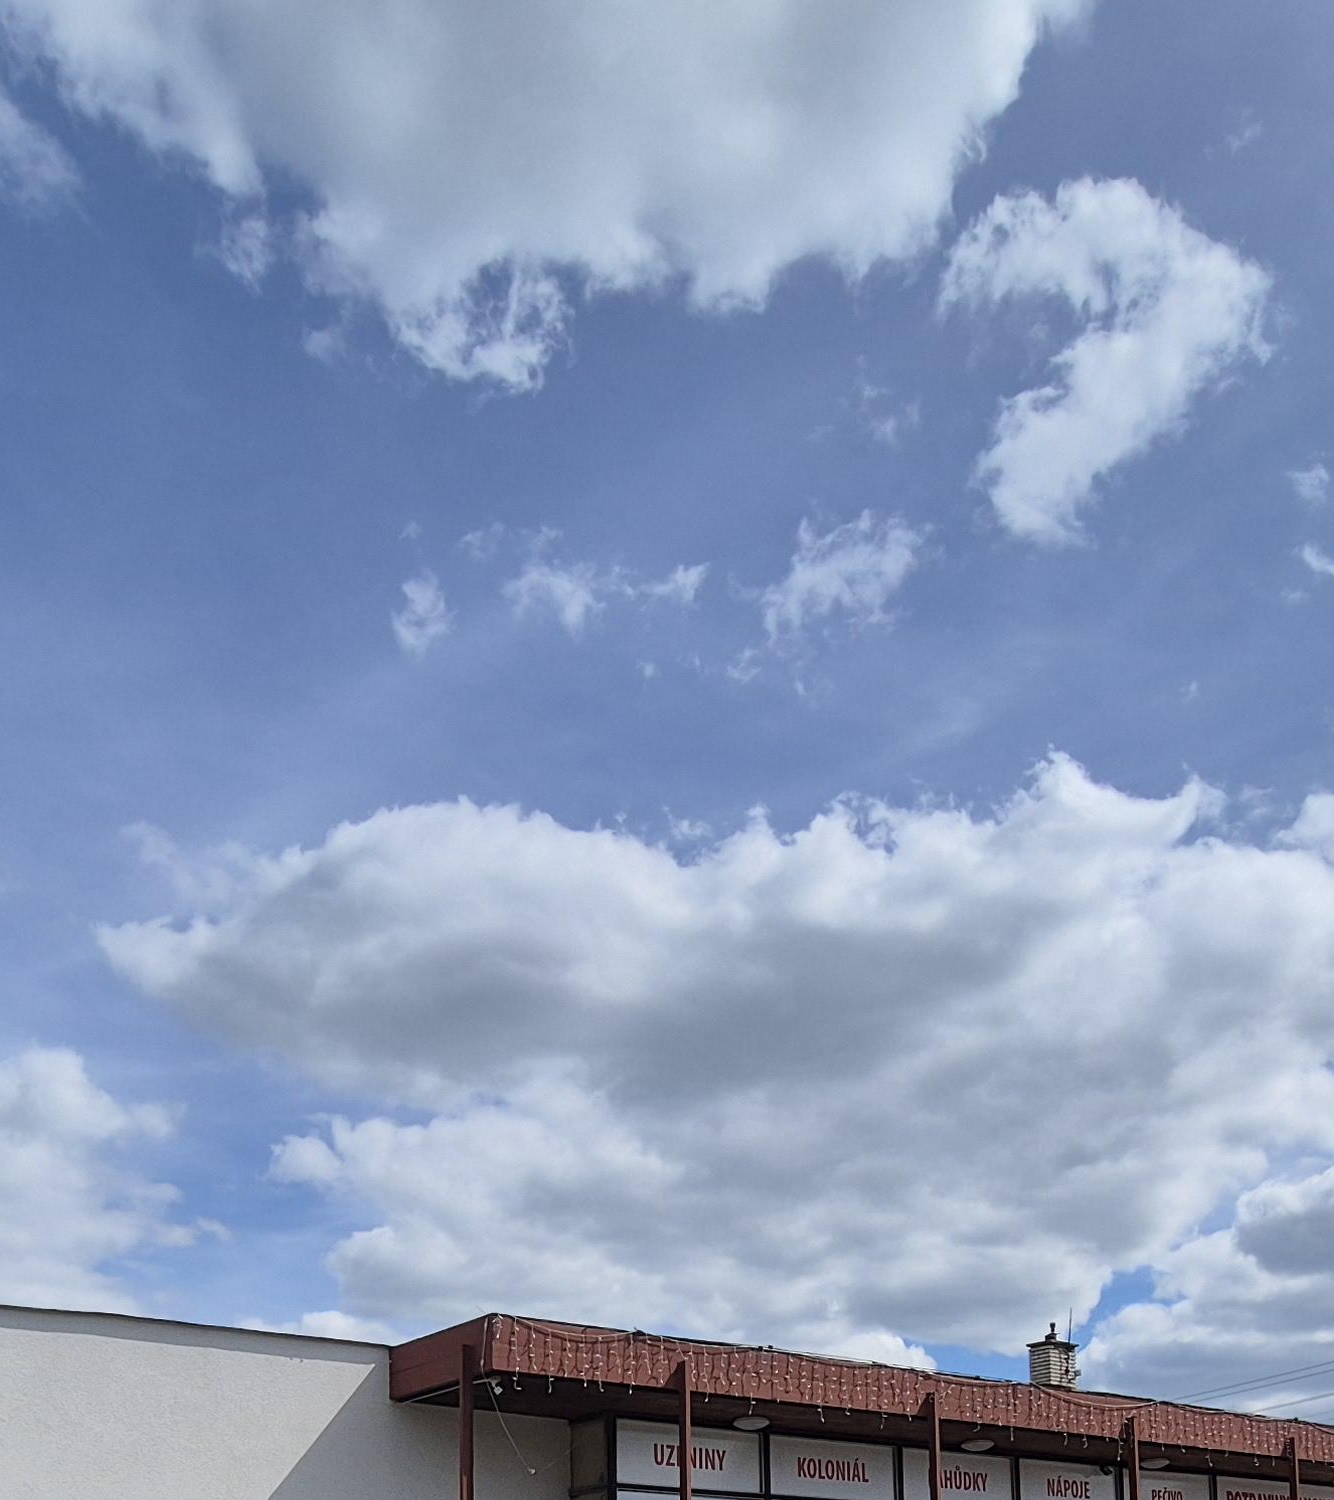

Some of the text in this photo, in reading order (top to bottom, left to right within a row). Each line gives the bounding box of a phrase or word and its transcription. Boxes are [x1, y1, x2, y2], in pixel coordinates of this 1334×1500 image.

[797, 1456, 869, 1483] KOLONIÁL
[939, 1465, 988, 1492] HŮDKY
[1047, 1475, 1090, 1499] NÁPOJE
